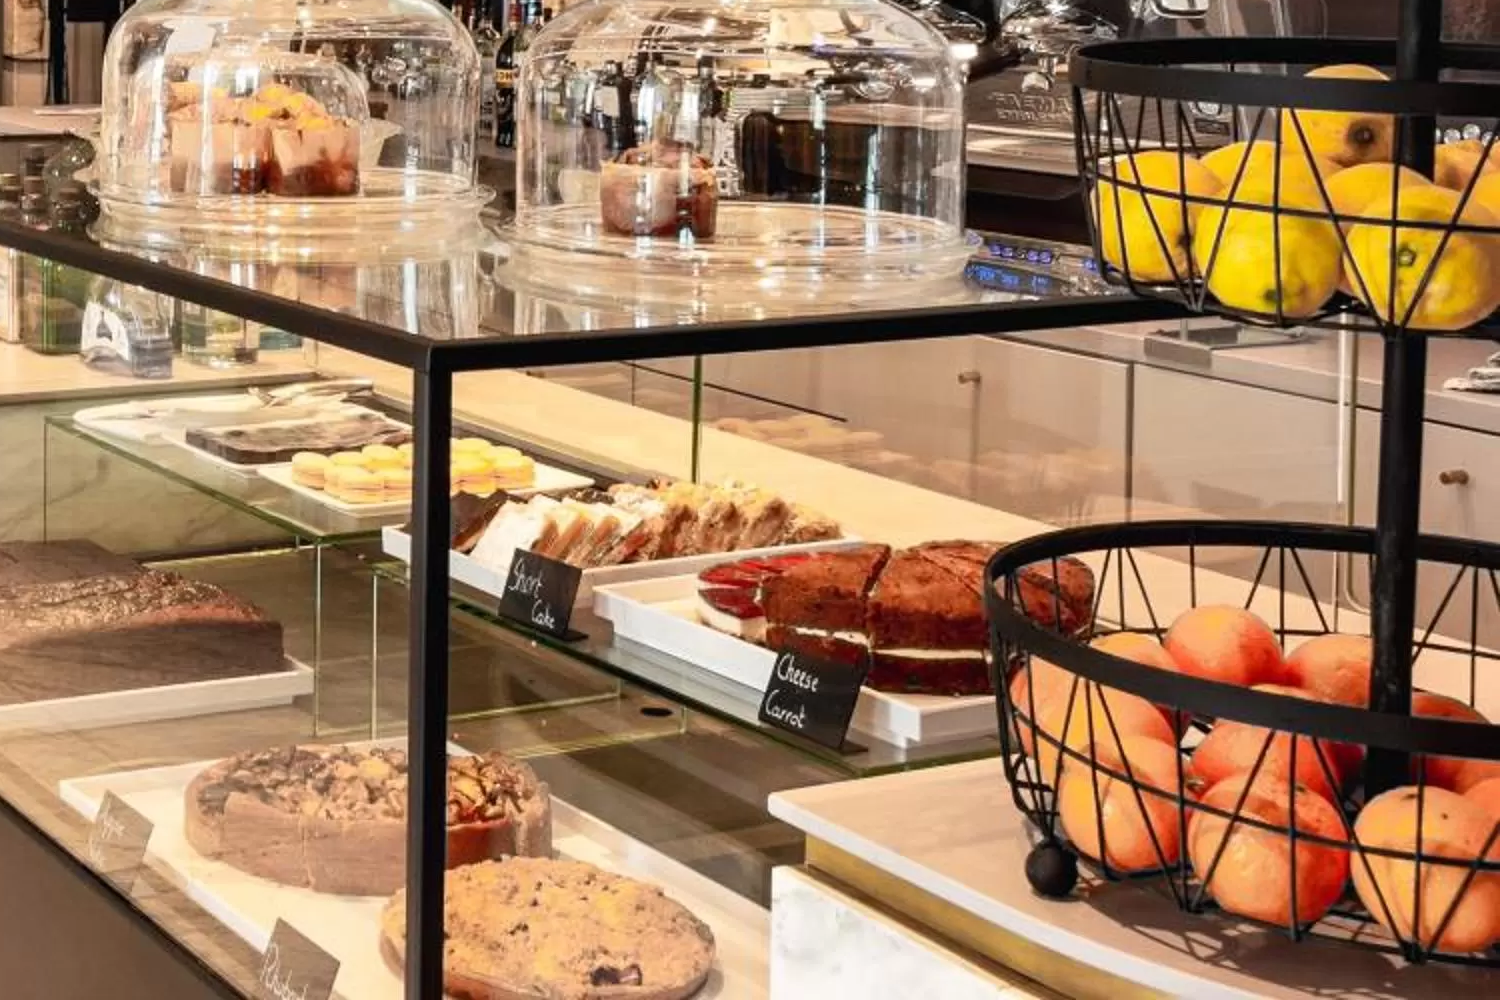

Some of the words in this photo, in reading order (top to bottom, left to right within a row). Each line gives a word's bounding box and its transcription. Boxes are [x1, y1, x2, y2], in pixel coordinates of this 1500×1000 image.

[531, 599, 555, 629] Cake
[777, 653, 819, 692] Cheese
[765, 689, 806, 729] Carrot
